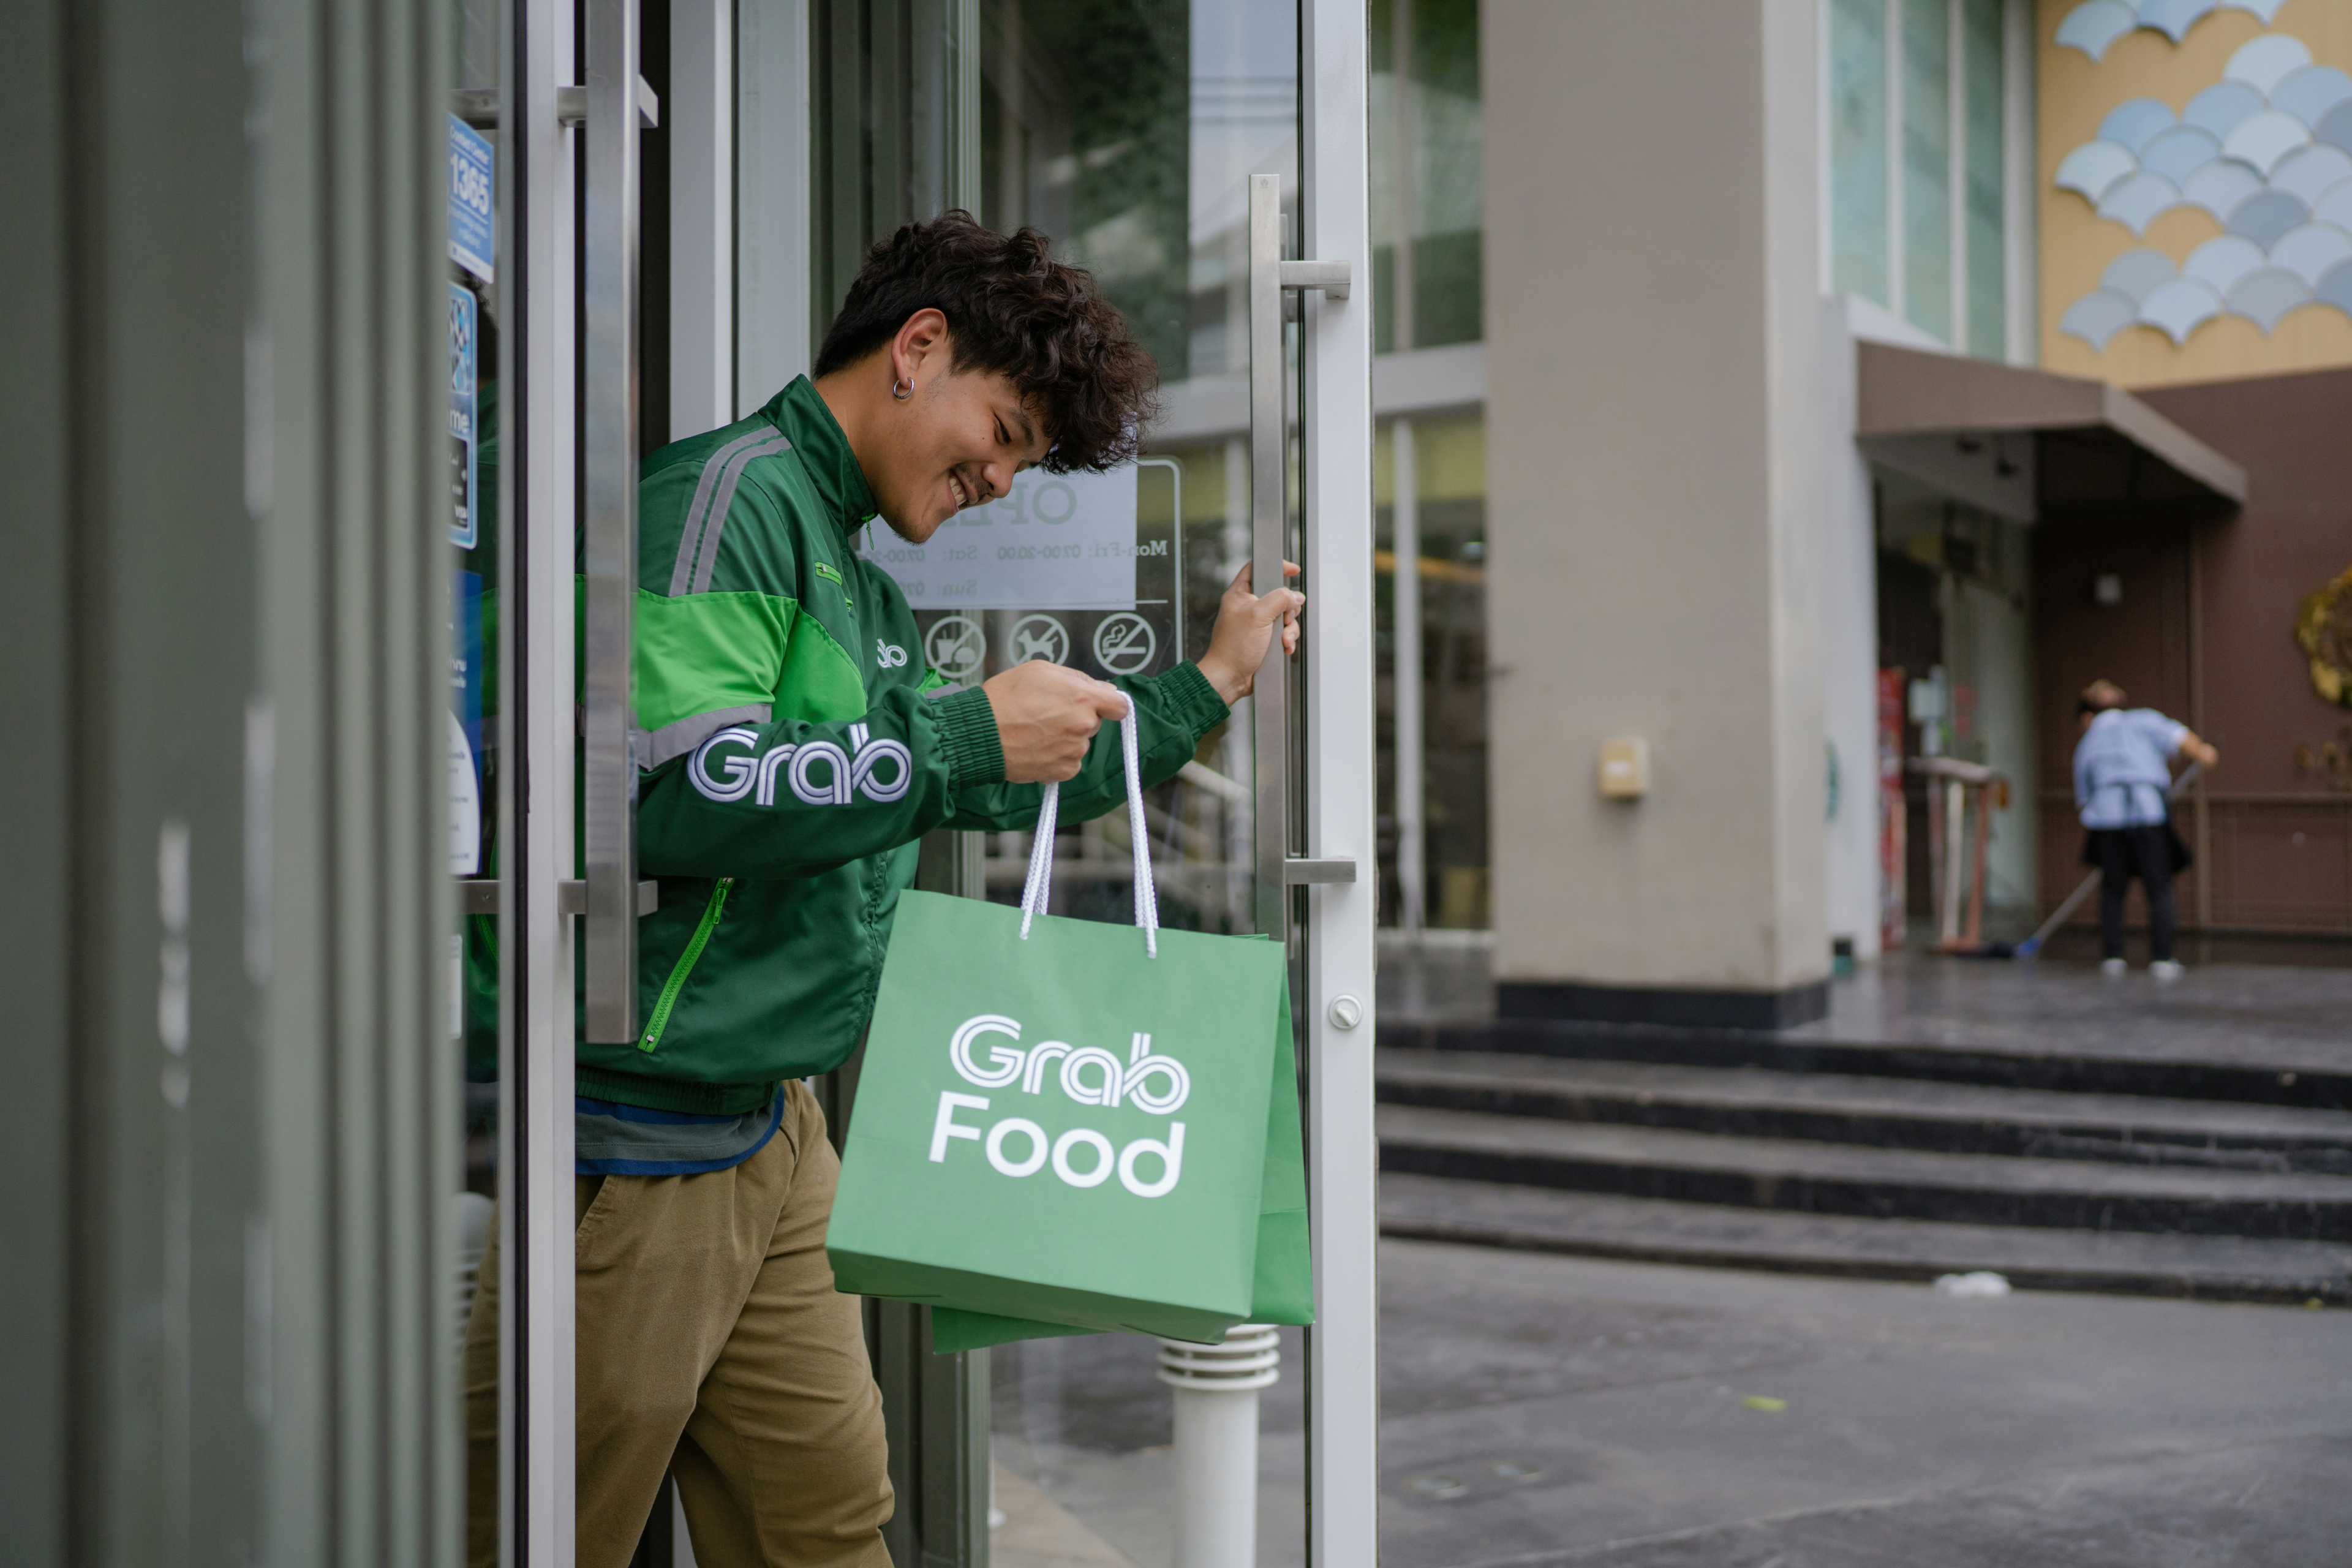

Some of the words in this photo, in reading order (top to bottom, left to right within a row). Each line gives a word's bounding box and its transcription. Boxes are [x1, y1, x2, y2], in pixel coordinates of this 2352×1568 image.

[450, 153, 489, 216] 1365
[687, 723, 912, 806] Grab
[949, 1014, 1191, 1115] Grab
[929, 1090, 1186, 1198] Food
